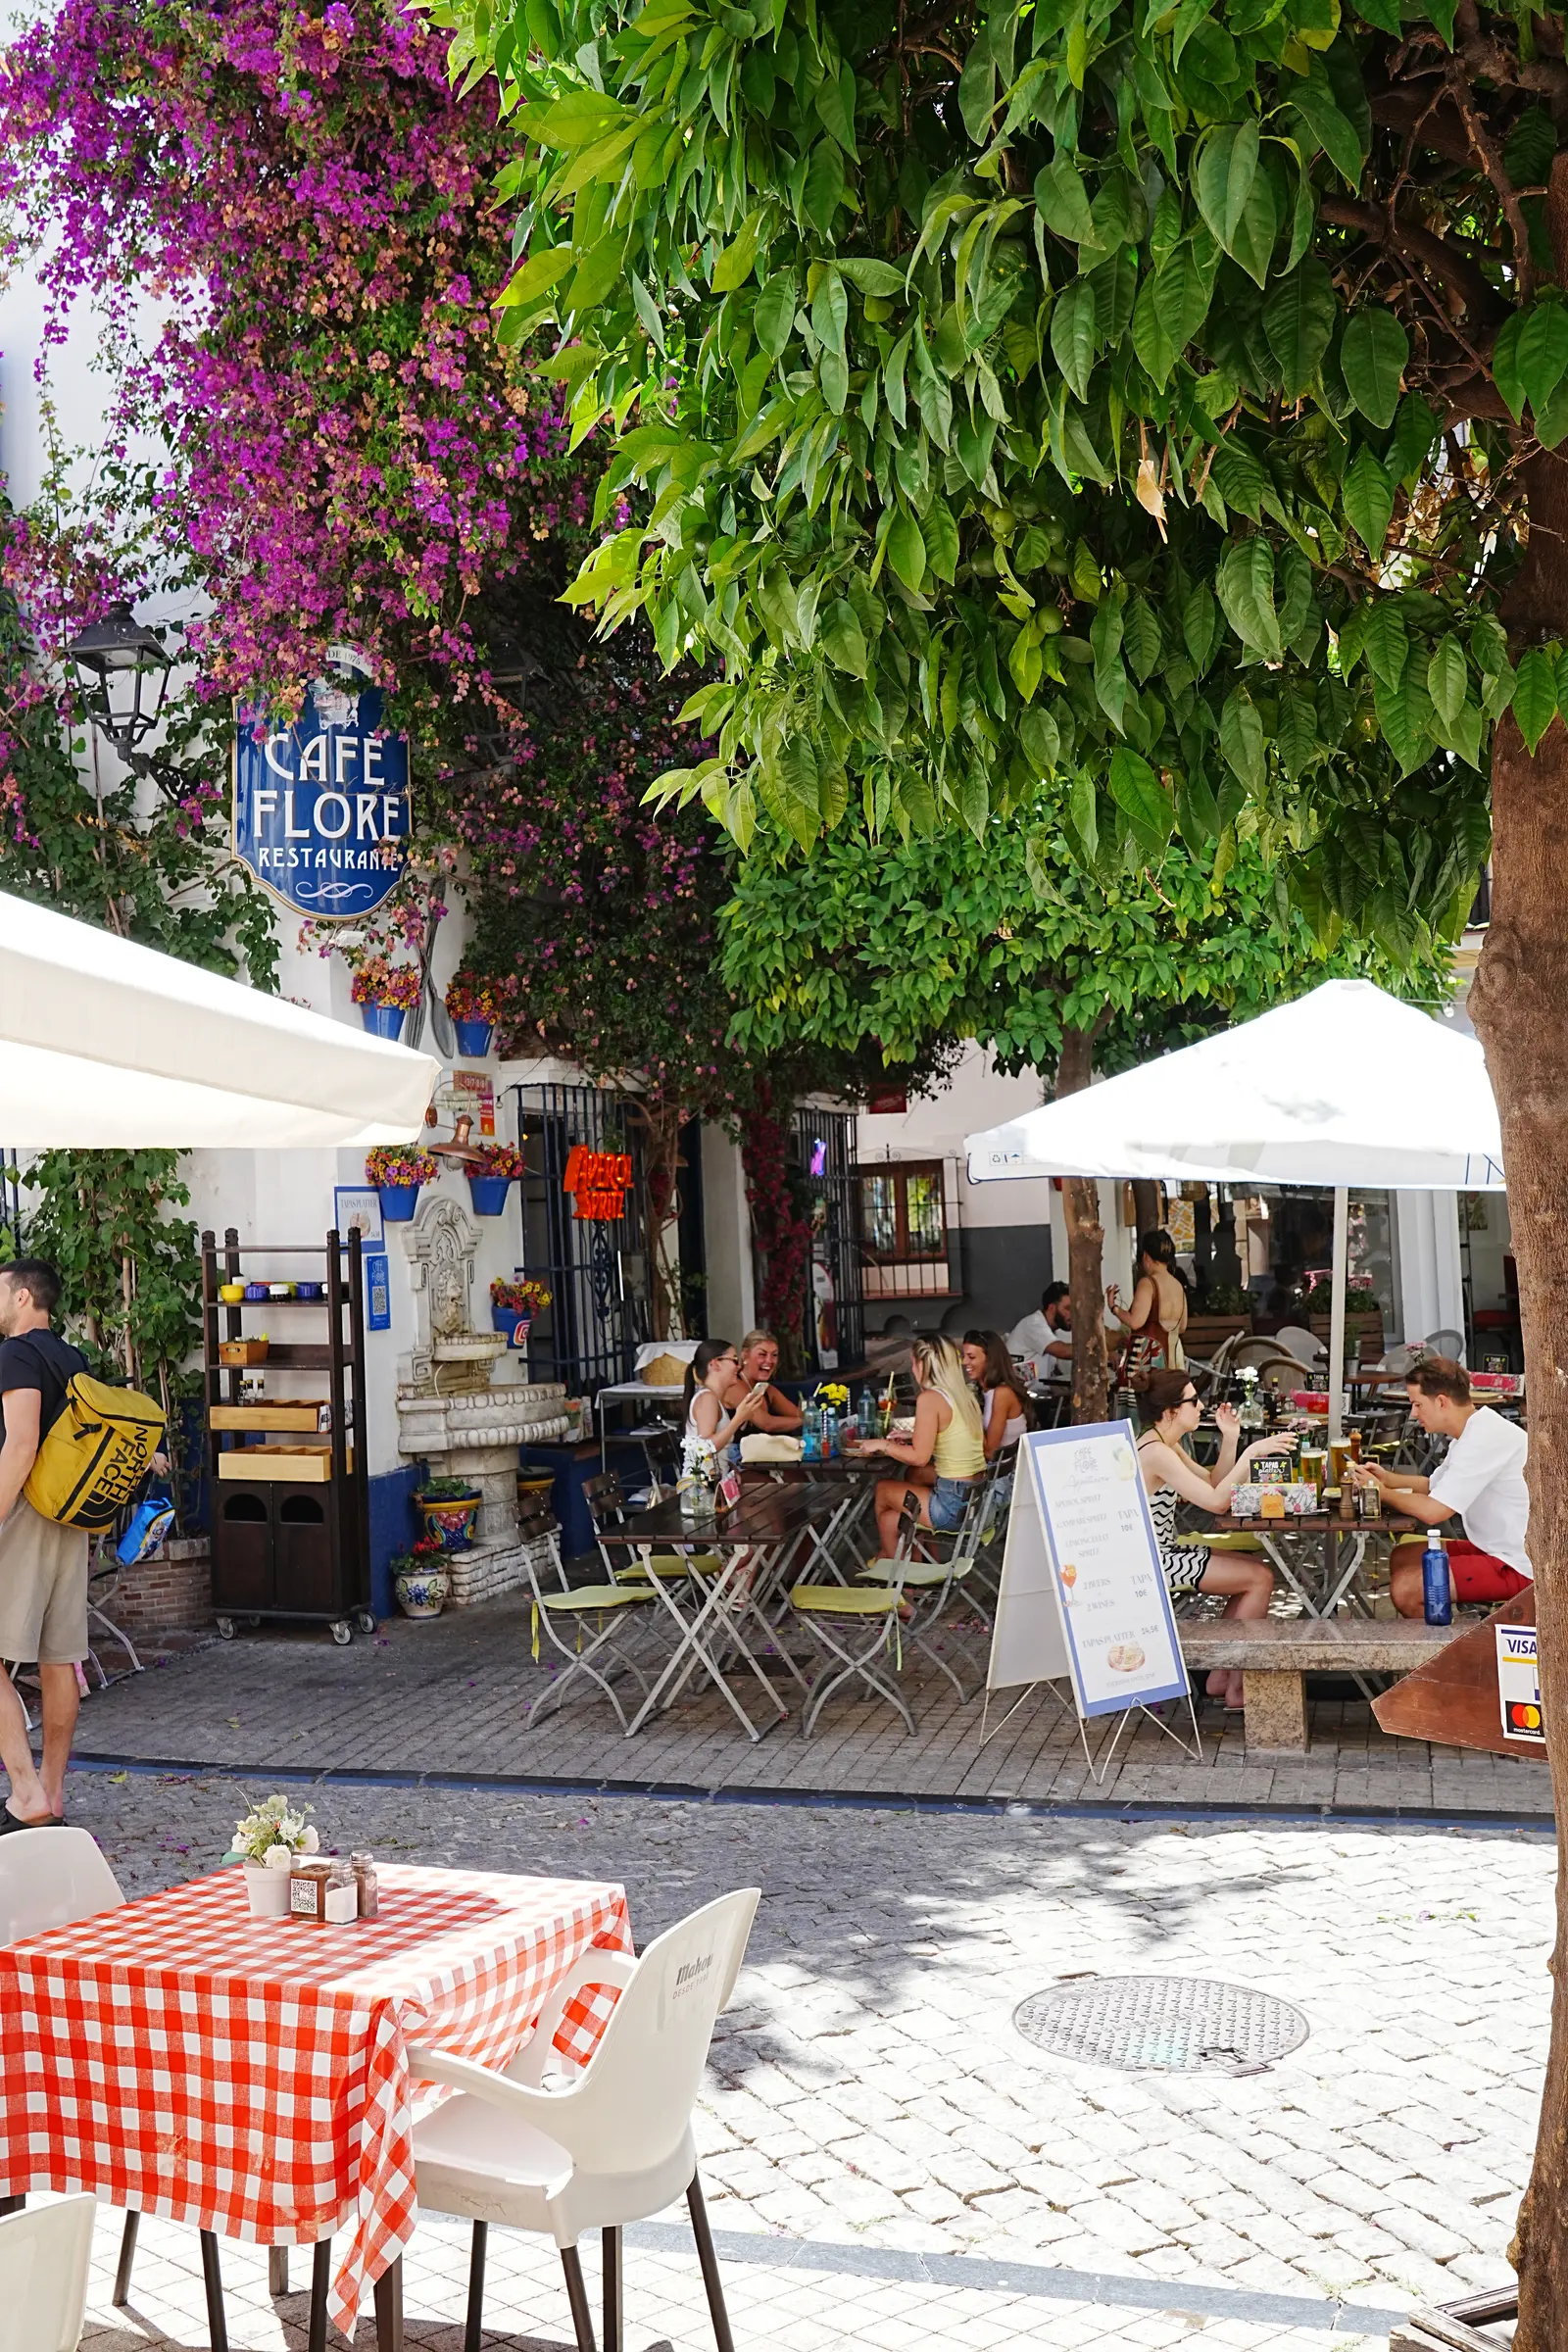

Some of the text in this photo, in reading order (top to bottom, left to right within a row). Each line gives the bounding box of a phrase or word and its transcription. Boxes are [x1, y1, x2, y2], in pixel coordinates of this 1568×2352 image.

[253, 790, 402, 842] FLORE
[259, 847, 399, 872] RESTAURANE
[94, 1437, 136, 1494] FACE
[1118, 1508, 1139, 1520] TAPA
[1130, 1573, 1152, 1585] TAPA
[1505, 1638, 1538, 1655] VISA
[676, 1953, 713, 1985] Mahou
[672, 1982, 694, 1999] DESDE
